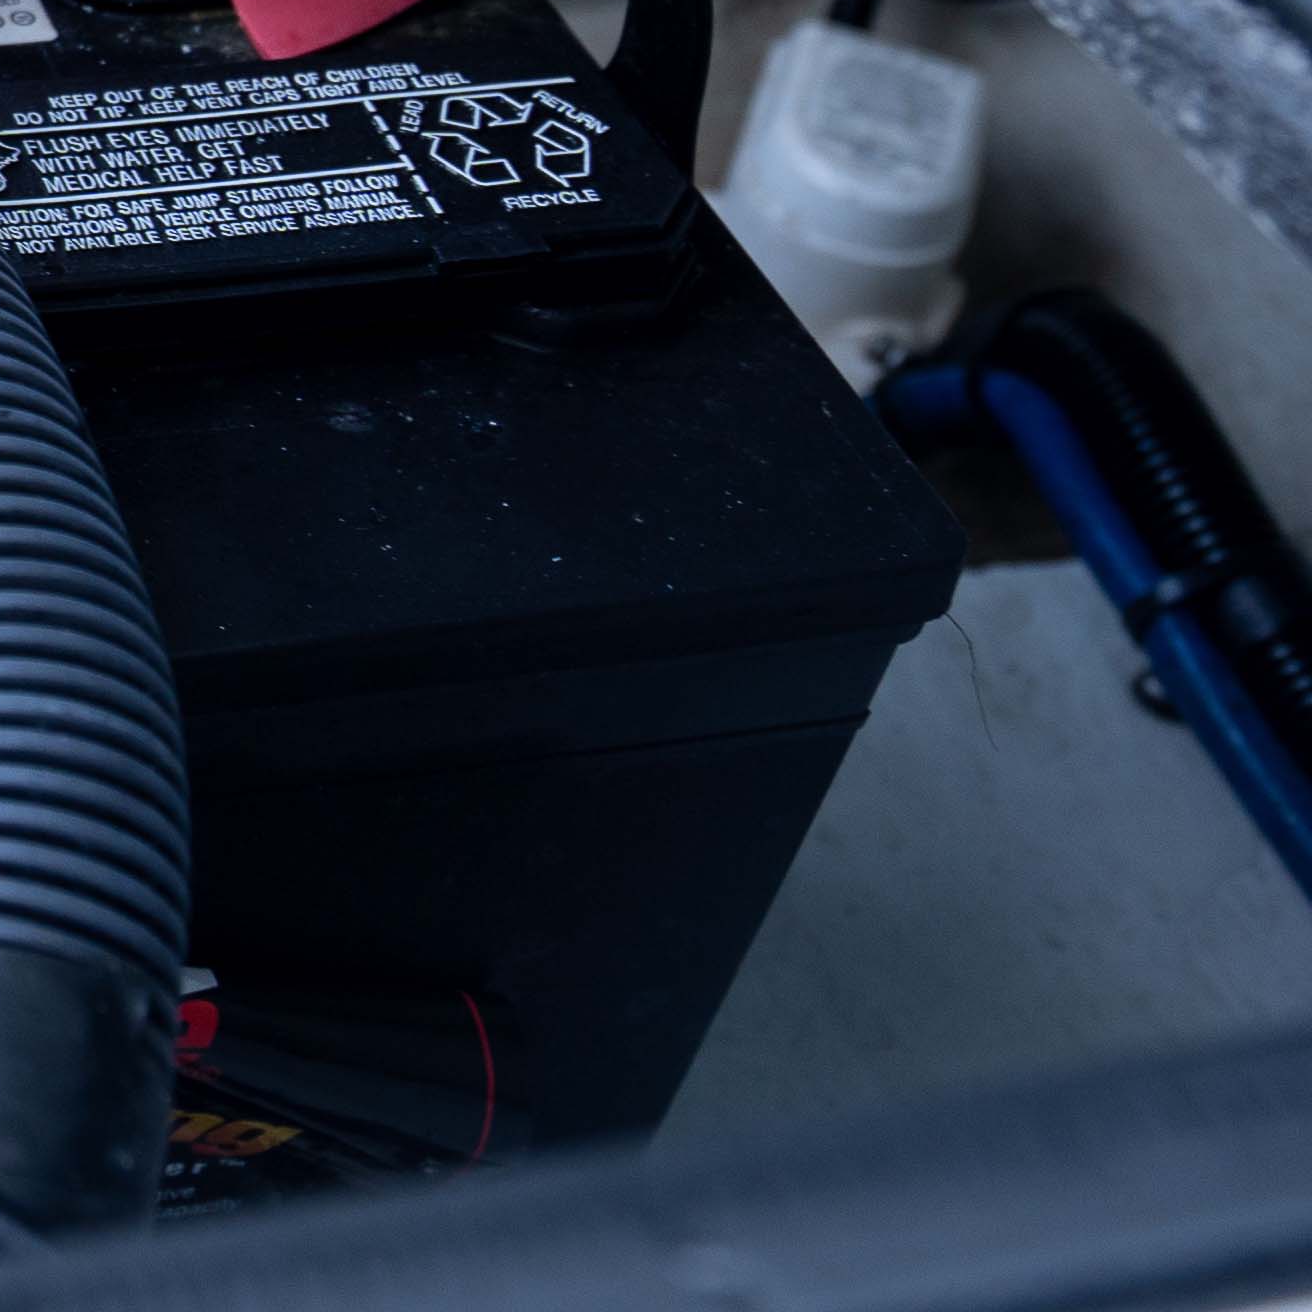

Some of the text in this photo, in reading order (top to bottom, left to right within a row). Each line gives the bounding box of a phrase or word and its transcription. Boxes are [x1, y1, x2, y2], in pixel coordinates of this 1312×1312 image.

[13, 71, 471, 126] DO NOT TIP. KEEP VENT CAPS TIGHT AND LEVEL
[47, 62, 421, 109] KEEP OUT OF THE REACH OF CHILDREN
[22, 112, 330, 157] FLUSH EYES IMMEDIATELY
[400, 99, 425, 134] LEAD
[532, 90, 611, 135] RETURN
[31, 140, 246, 175] WITH WATER. GET
[41, 155, 287, 195] MEDICAL HELP FAST
[75, 204, 116, 222] FOR
[119, 198, 168, 216] SAFE
[172, 192, 221, 211] JUMP
[226, 182, 319, 206] STARTING
[324, 173, 399, 194] FOLLOW
[133, 215, 152, 231] IN
[157, 207, 236, 228] VEHICLE
[239, 199, 318, 221] OWNERS
[328, 191, 409, 211] MANUAL.
[500, 189, 602, 212] RECYCLE
[18, 236, 57, 255] NOT
[63, 231, 161, 252] AVAILABLE
[167, 226, 218, 244] SEEK
[221, 218, 299, 239] SERVICE
[304, 203, 424, 230] ASSISTANCE.
